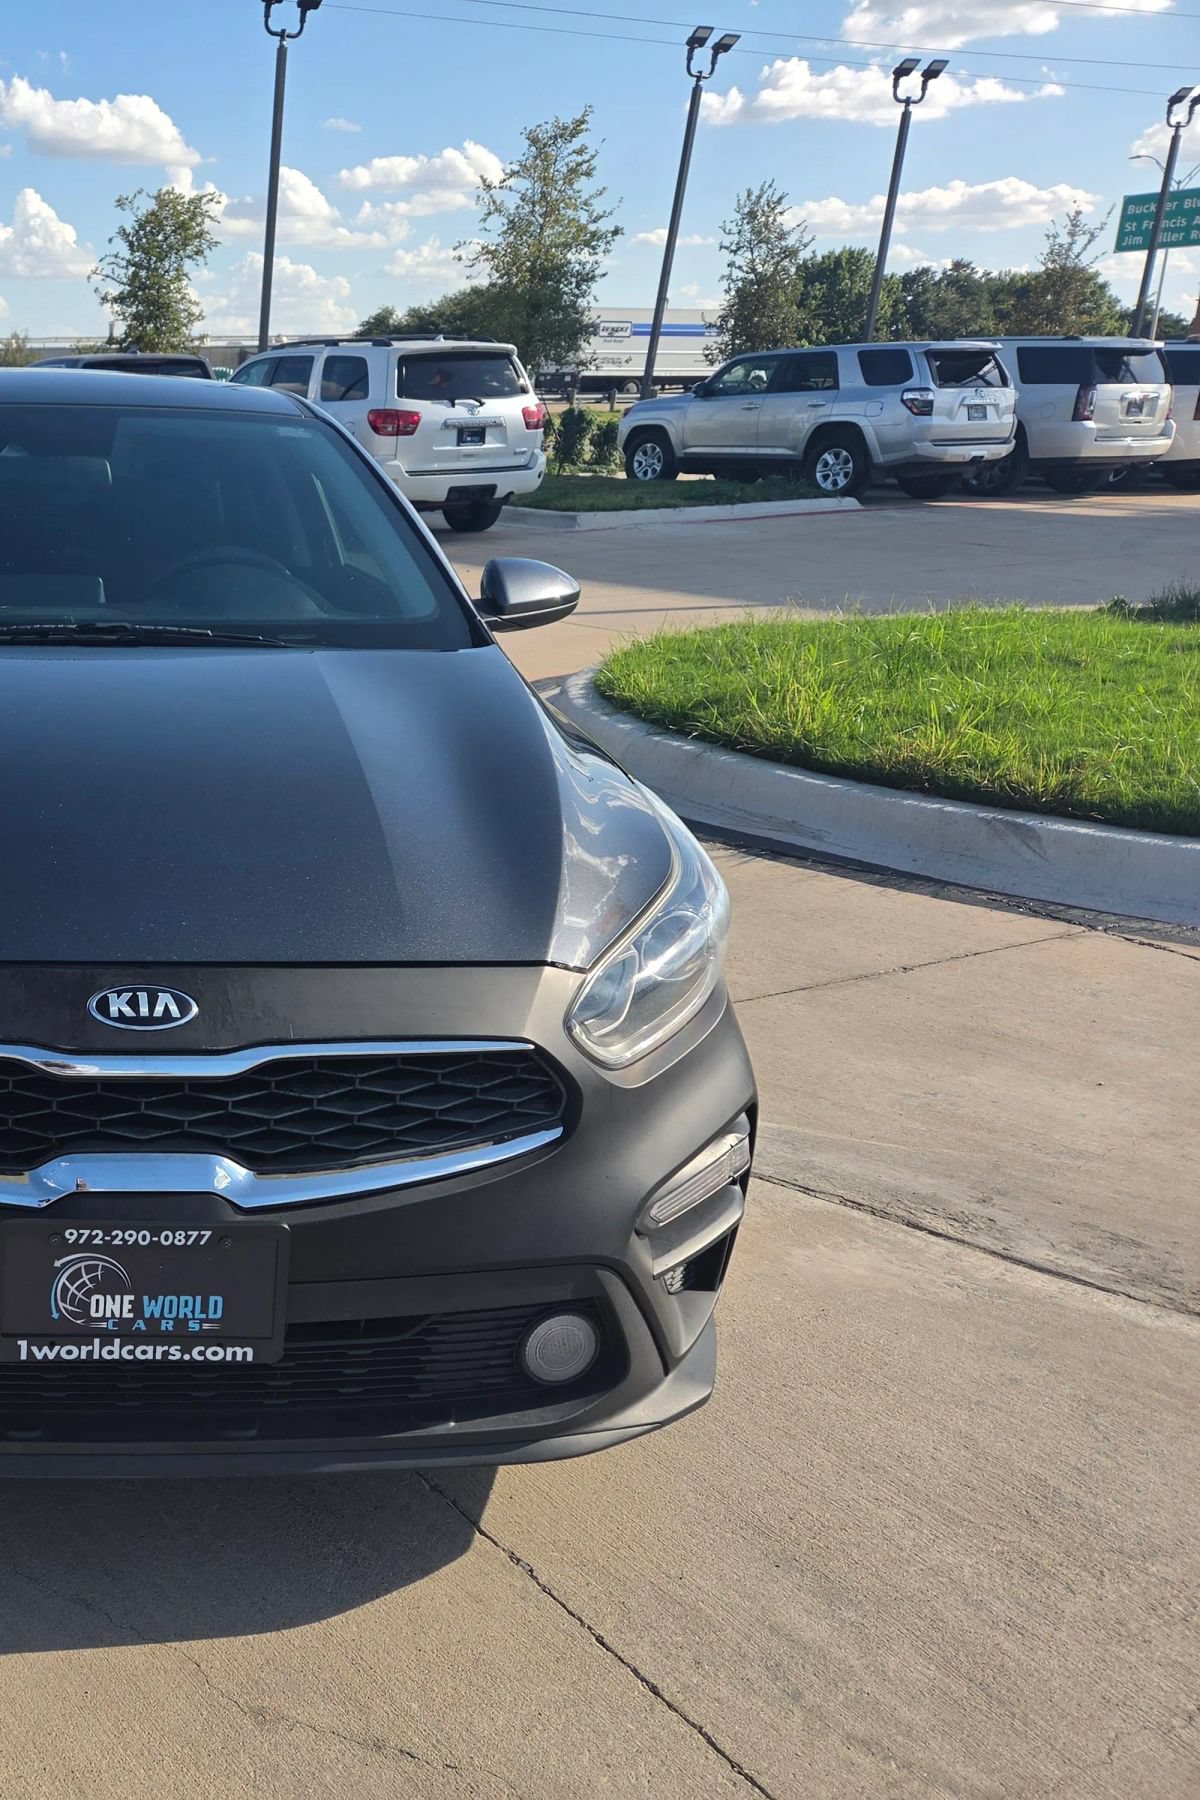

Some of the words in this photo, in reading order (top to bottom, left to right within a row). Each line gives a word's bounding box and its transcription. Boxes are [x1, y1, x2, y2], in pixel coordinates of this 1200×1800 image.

[1127, 202, 1179, 214] Bucker
[1124, 221, 1137, 232] St
[1142, 217, 1187, 229] Frncis
[1121, 235, 1143, 246] Jim
[1158, 232, 1185, 243] iller
[106, 991, 182, 1018] KIA
[64, 1228, 213, 1246] 972-290-0877
[89, 1294, 135, 1319] ONE
[142, 1295, 224, 1320] WORLD
[106, 1319, 201, 1332] CARS
[16, 1337, 254, 1363] 1worldcars.com
